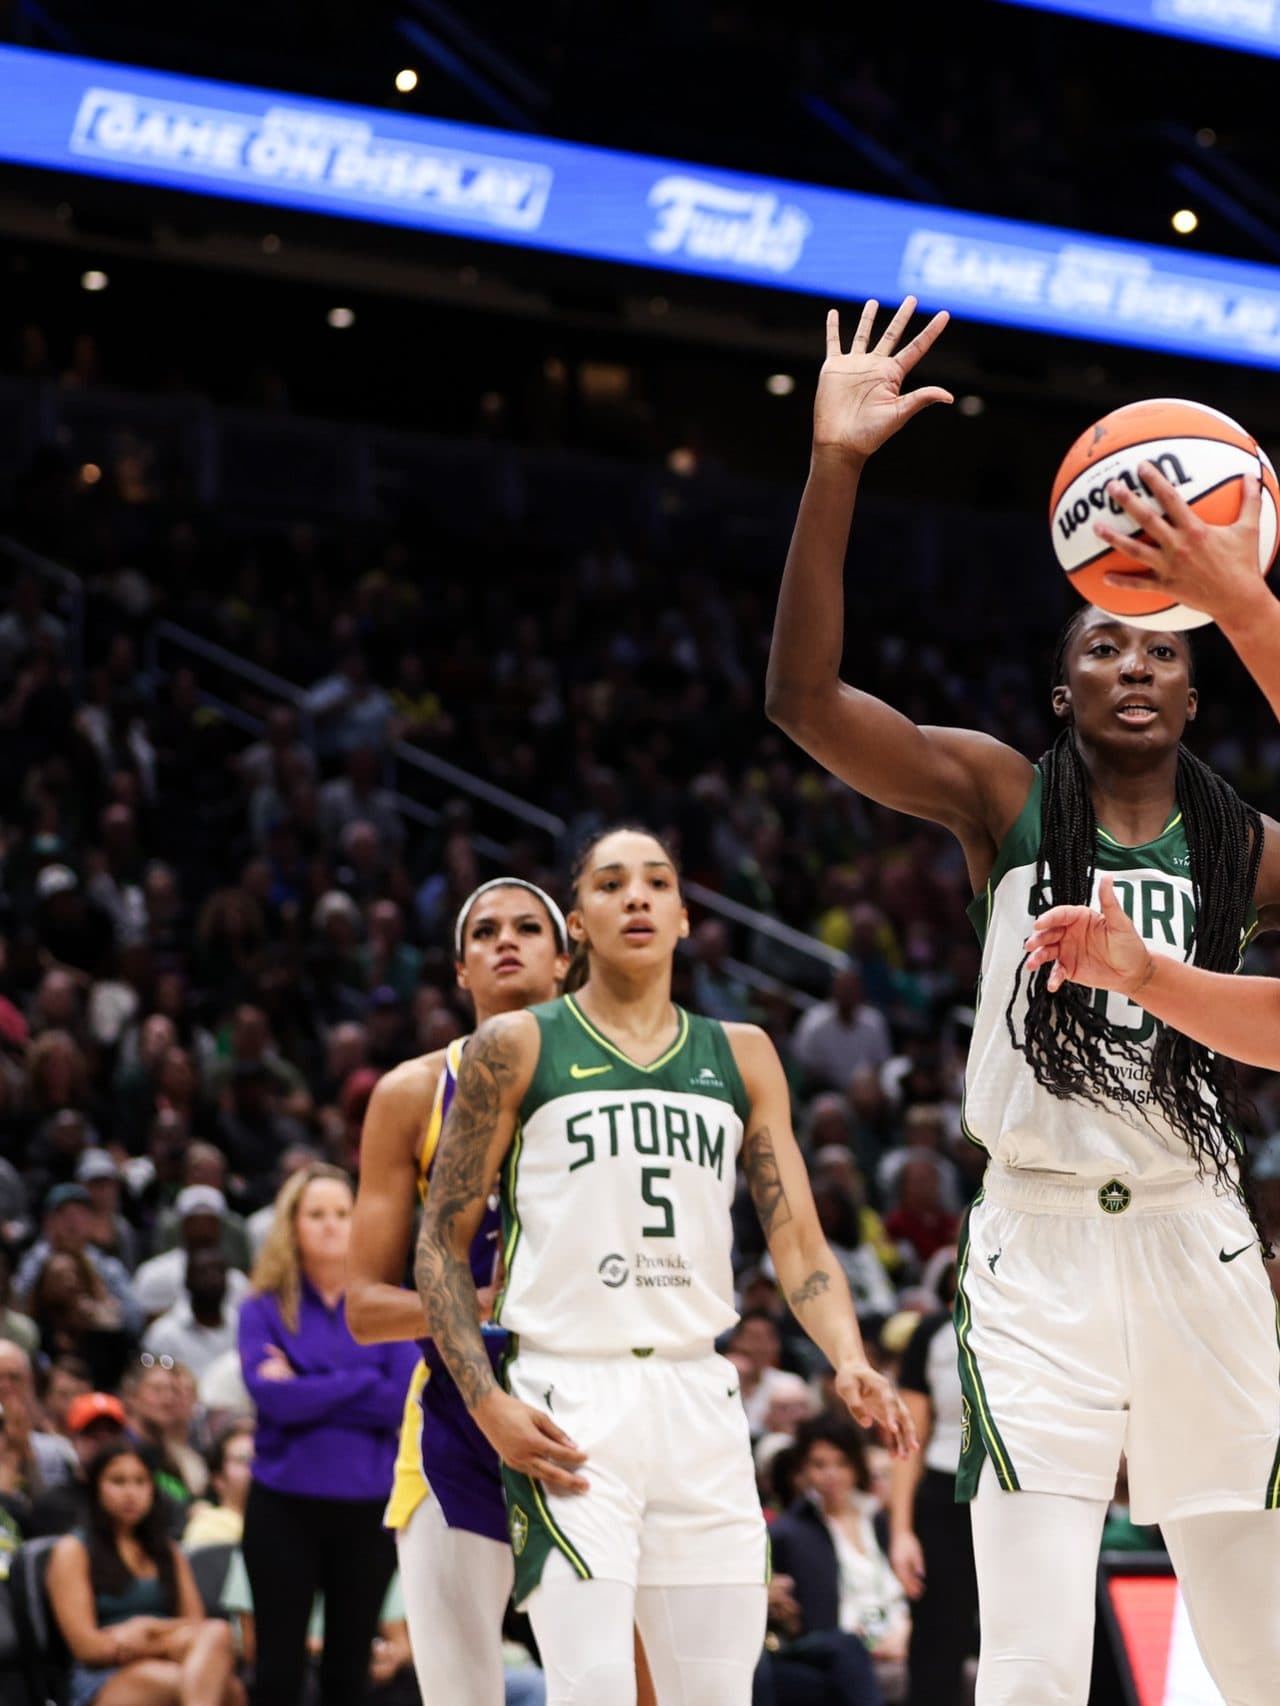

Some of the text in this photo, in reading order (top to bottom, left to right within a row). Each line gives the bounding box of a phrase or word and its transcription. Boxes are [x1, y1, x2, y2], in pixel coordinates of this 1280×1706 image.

[97, 100, 248, 169] GAME
[251, 134, 331, 183] ON
[332, 143, 532, 211] DISPLAY
[647, 176, 812, 272] Funko
[566, 1100, 725, 1181] STORM
[641, 1167, 676, 1238] 5
